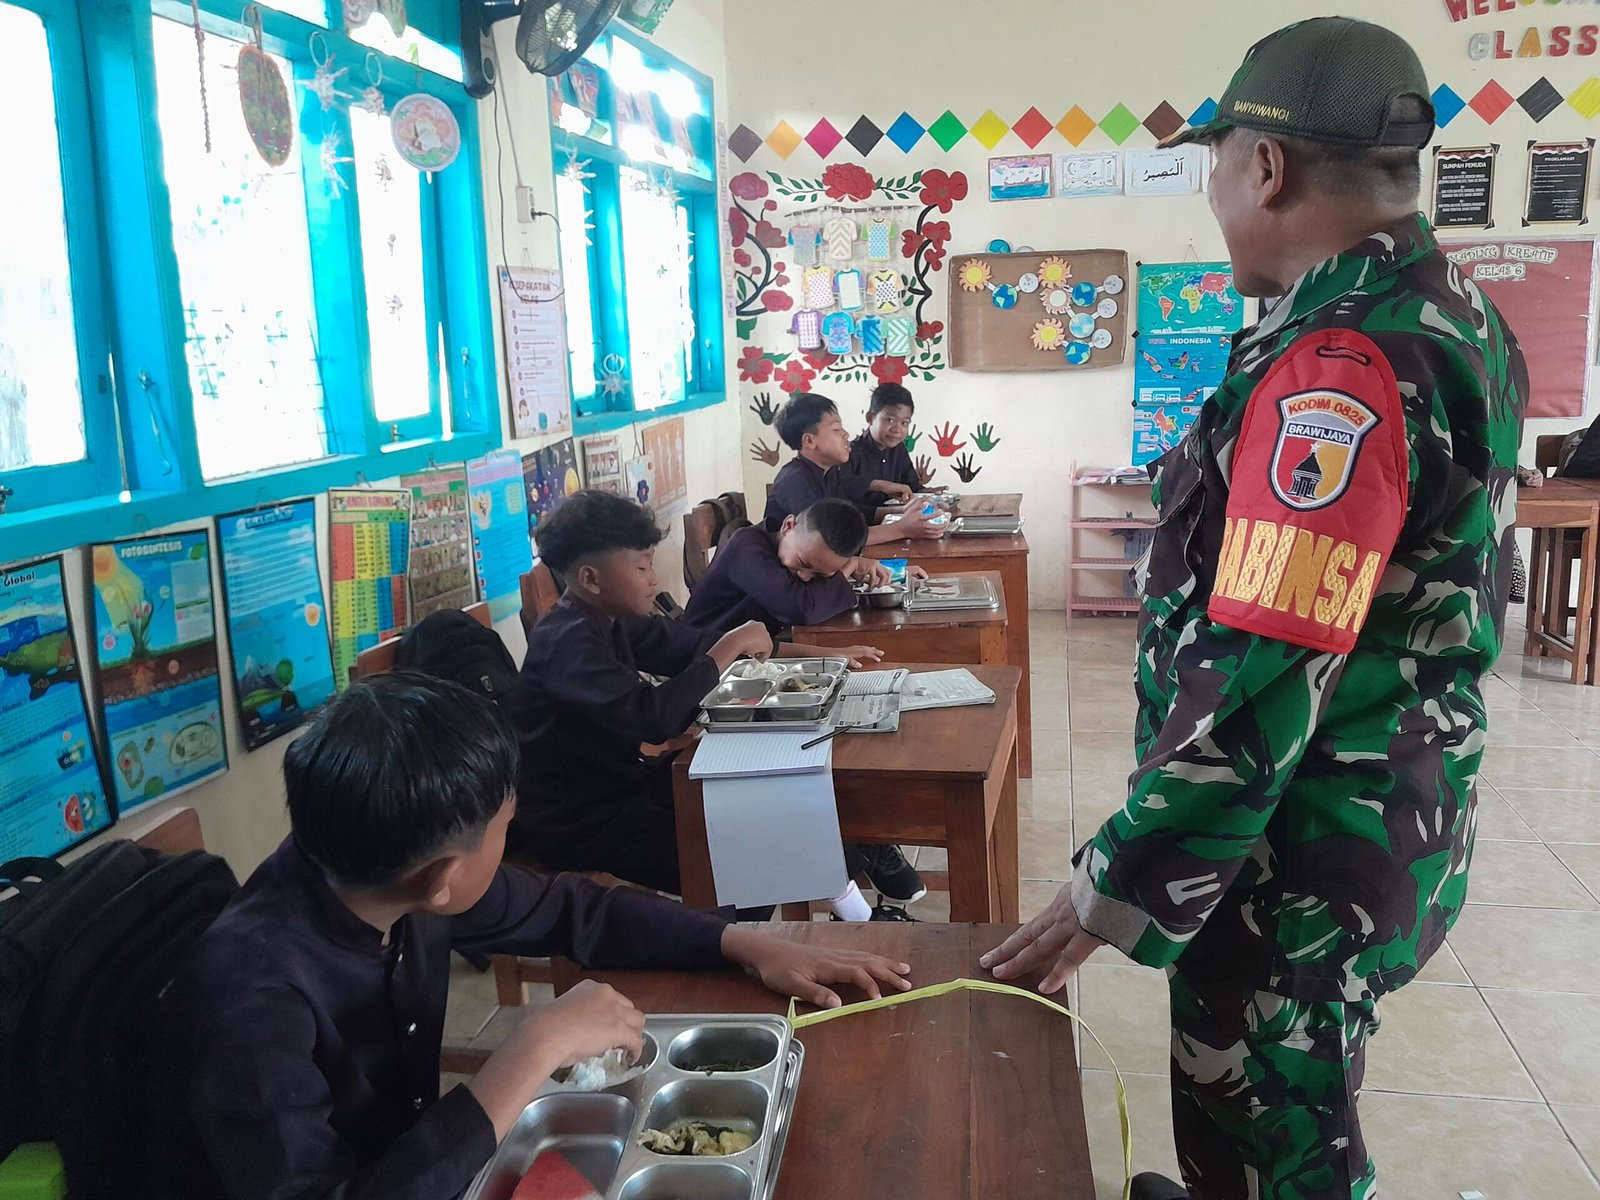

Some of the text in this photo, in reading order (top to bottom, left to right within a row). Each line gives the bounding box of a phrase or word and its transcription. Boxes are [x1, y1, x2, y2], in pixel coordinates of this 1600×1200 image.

[1469, 25, 1599, 61] CLASS
[1507, 246, 1554, 261] KREATIF
[1476, 265, 1522, 277] KELAS 6
[1170, 337, 1212, 345] INDONESIA
[1288, 398, 1367, 426] KODIM 0825
[1288, 424, 1351, 445] BRAWIJAYA
[4, 571, 35, 587] Global
